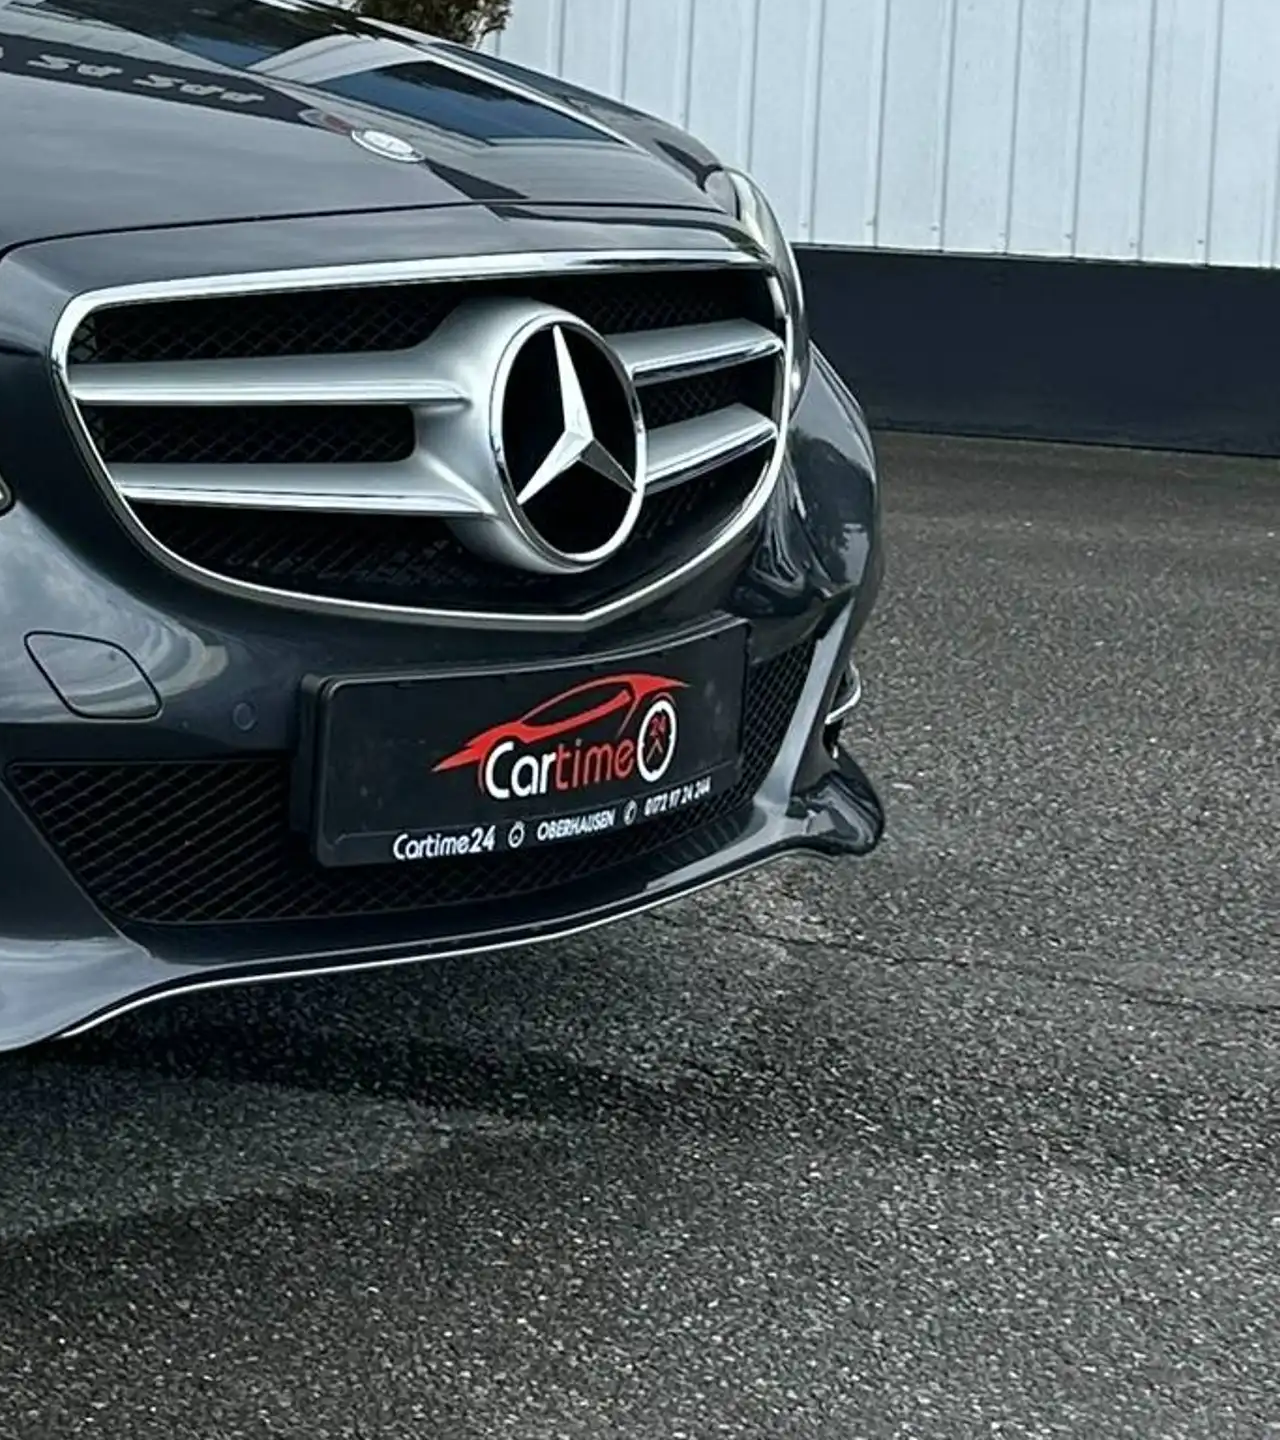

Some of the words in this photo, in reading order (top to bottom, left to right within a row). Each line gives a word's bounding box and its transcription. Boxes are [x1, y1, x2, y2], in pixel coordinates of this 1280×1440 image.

[485, 738, 635, 800] Cartime
[393, 825, 496, 860] Cartime24
[537, 809, 616, 841] OBERHAUSEN
